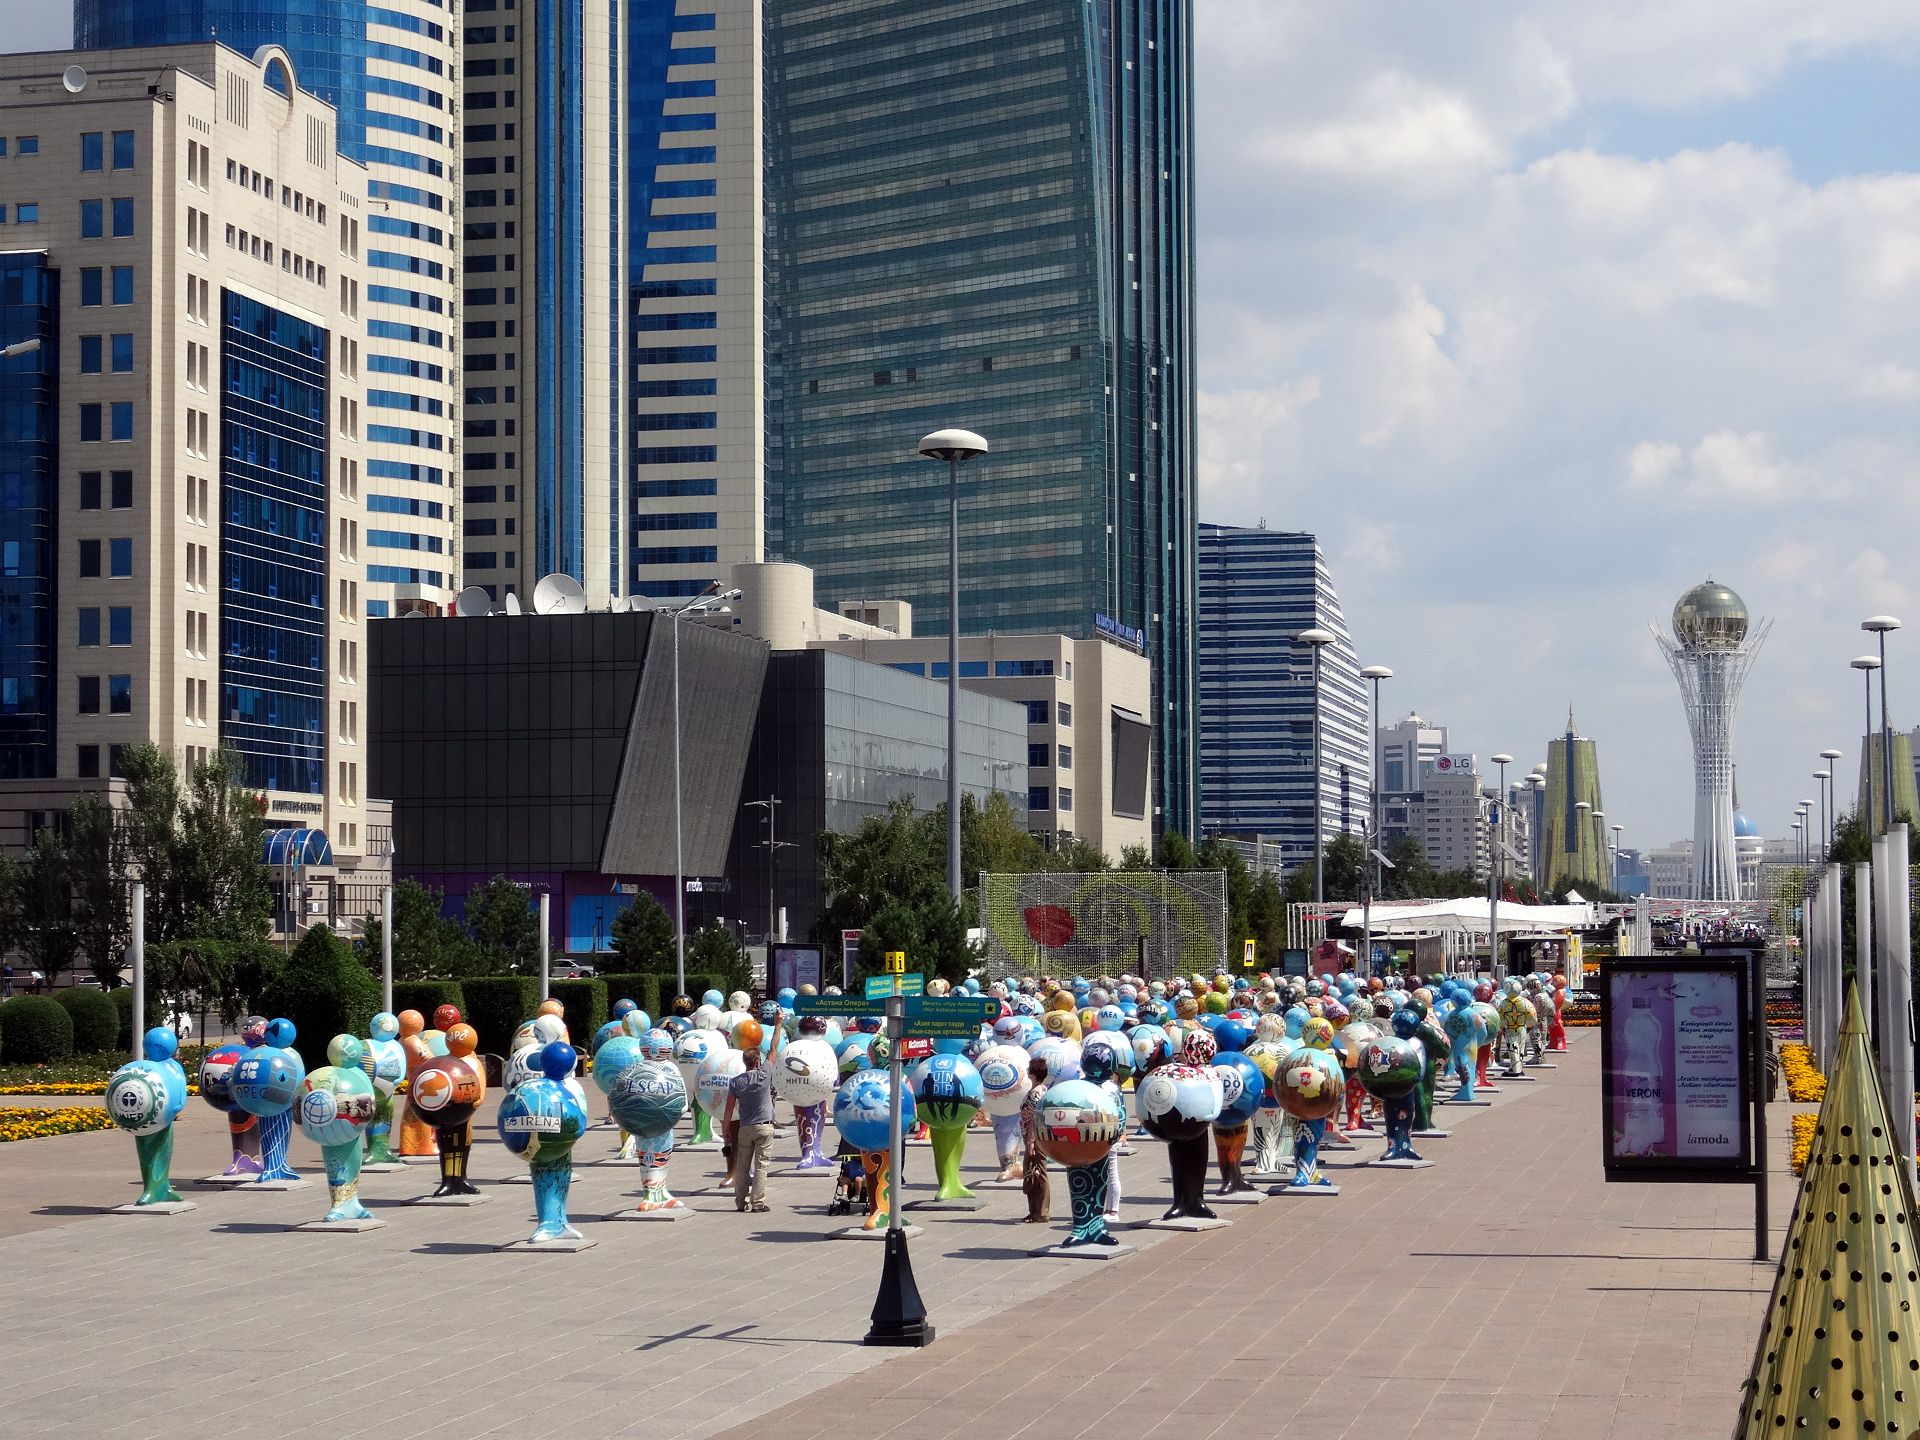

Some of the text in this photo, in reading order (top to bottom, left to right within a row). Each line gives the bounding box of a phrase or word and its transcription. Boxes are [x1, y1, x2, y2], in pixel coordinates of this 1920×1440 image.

[1454, 758, 1470, 768] LG
[236, 1086, 268, 1098] OPEC
[521, 1117, 560, 1127] IRENA
[1687, 1133, 1729, 1145] lamoda
